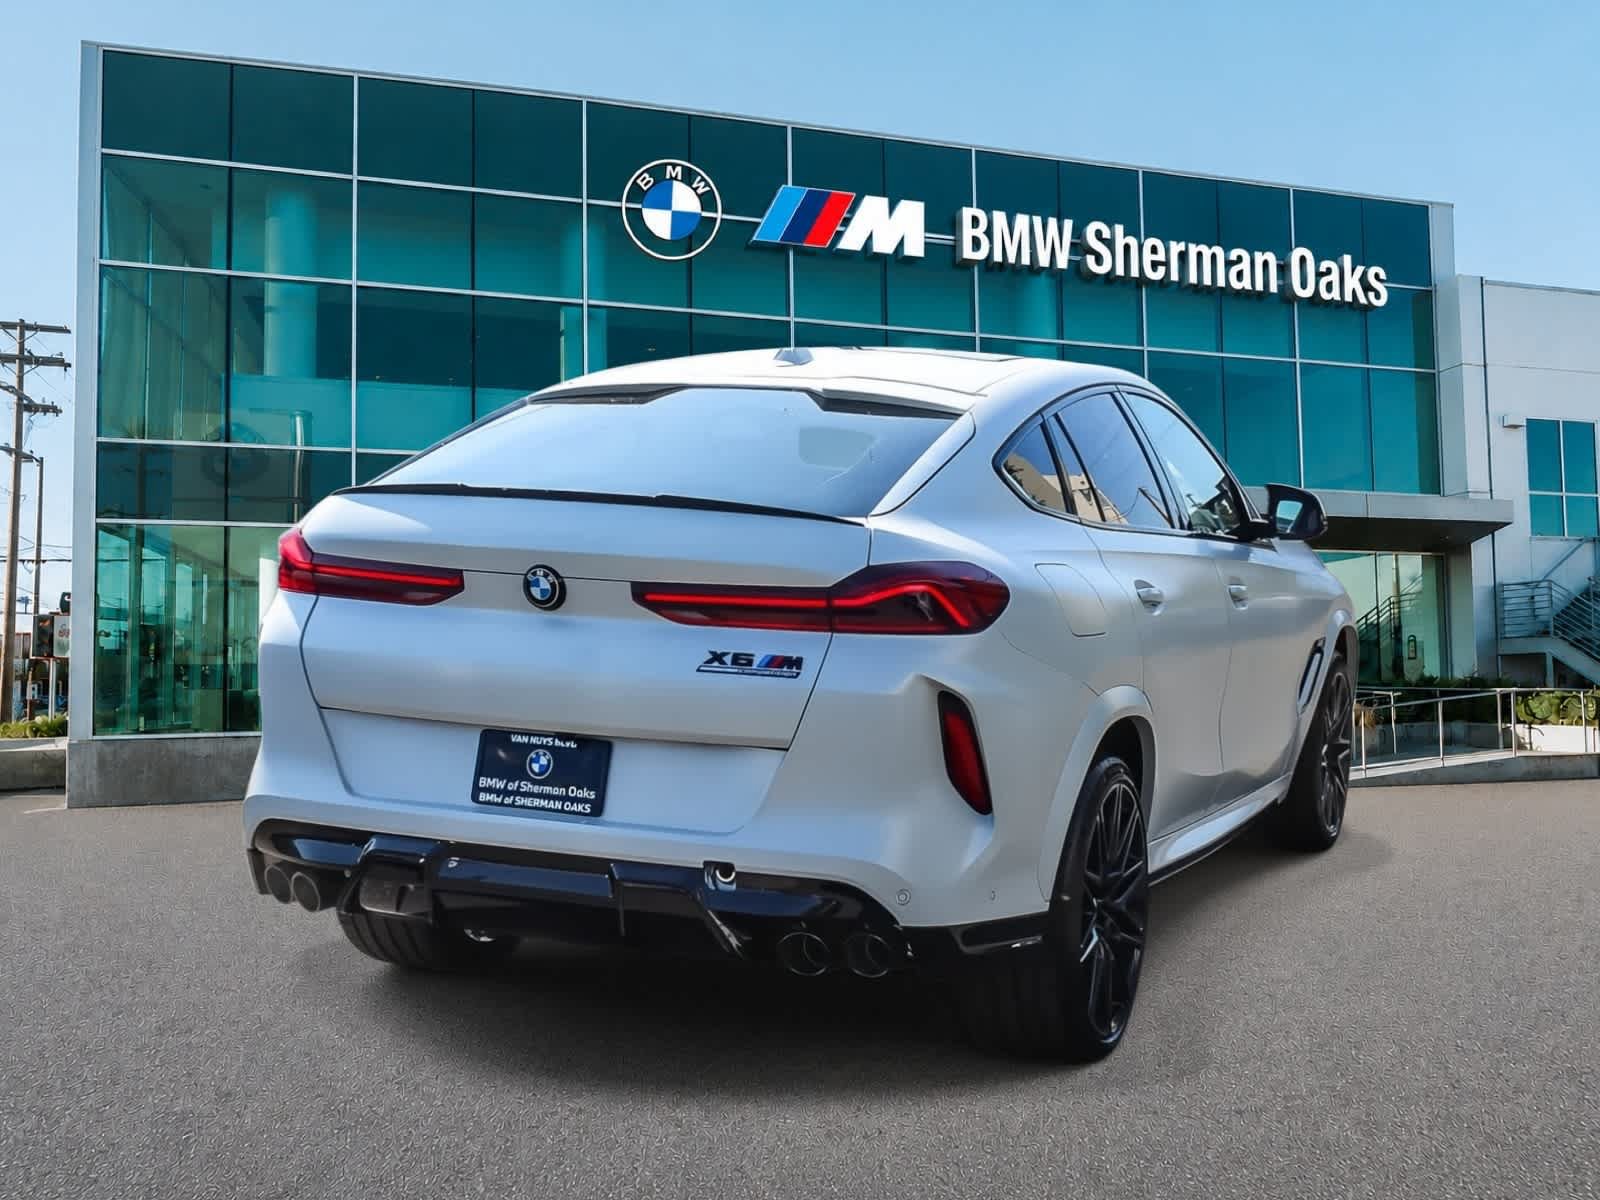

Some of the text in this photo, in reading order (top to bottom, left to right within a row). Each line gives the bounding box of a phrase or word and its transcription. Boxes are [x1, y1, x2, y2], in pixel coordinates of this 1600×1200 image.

[636, 164, 711, 194] BMW
[959, 206, 1388, 307] BMW Sherman Oaks
[703, 650, 755, 668] X6
[511, 734, 529, 744] VAN
[530, 736, 553, 746] NUYS
[479, 776, 596, 799] BMW of Sherman Oaks
[479, 792, 592, 813] BMW of SHERMAN OAKS
